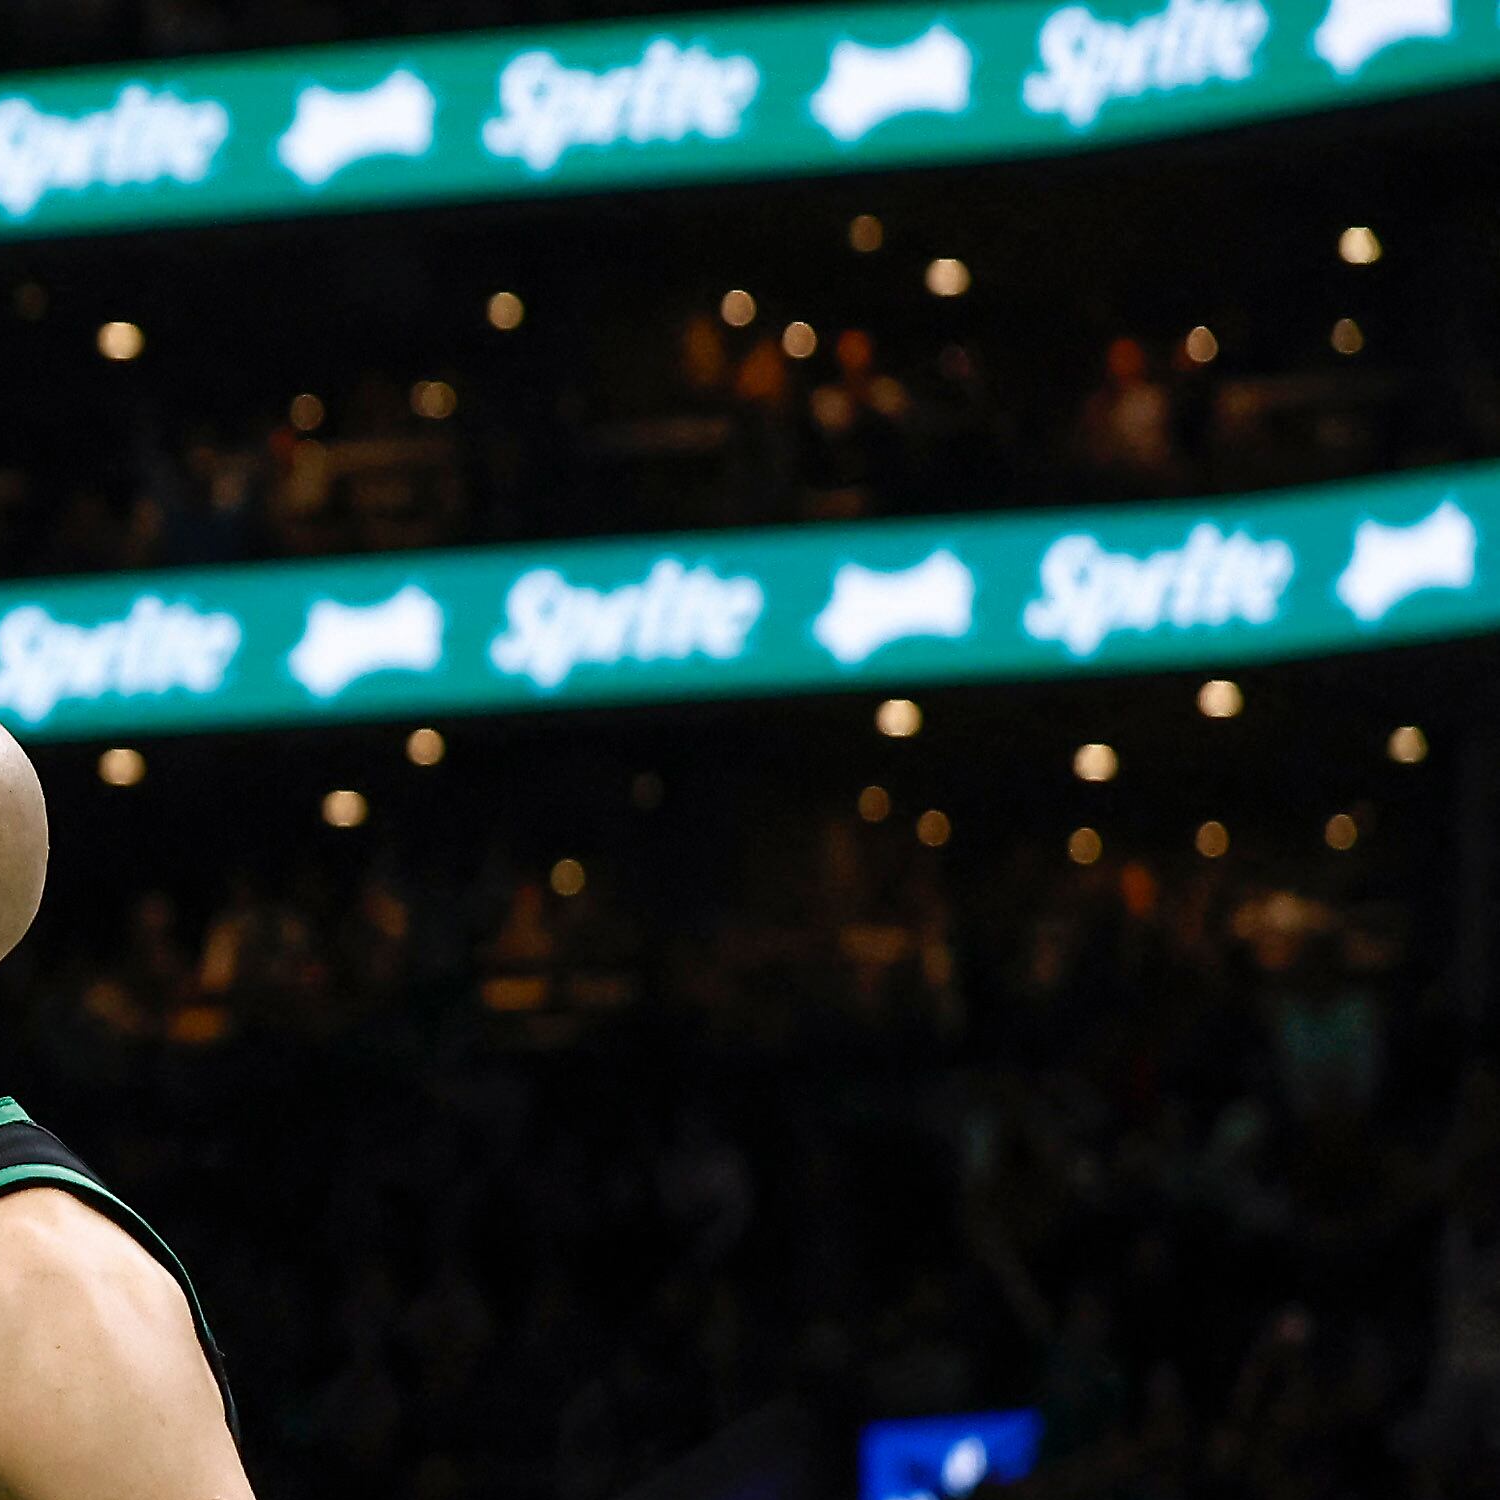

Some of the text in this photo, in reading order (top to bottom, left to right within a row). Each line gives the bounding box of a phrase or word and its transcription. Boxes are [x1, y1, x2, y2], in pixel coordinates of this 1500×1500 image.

[485, 40, 757, 169] Sprite
[492, 561, 762, 685] Sprite
[1025, 525, 1292, 653] Sprite
